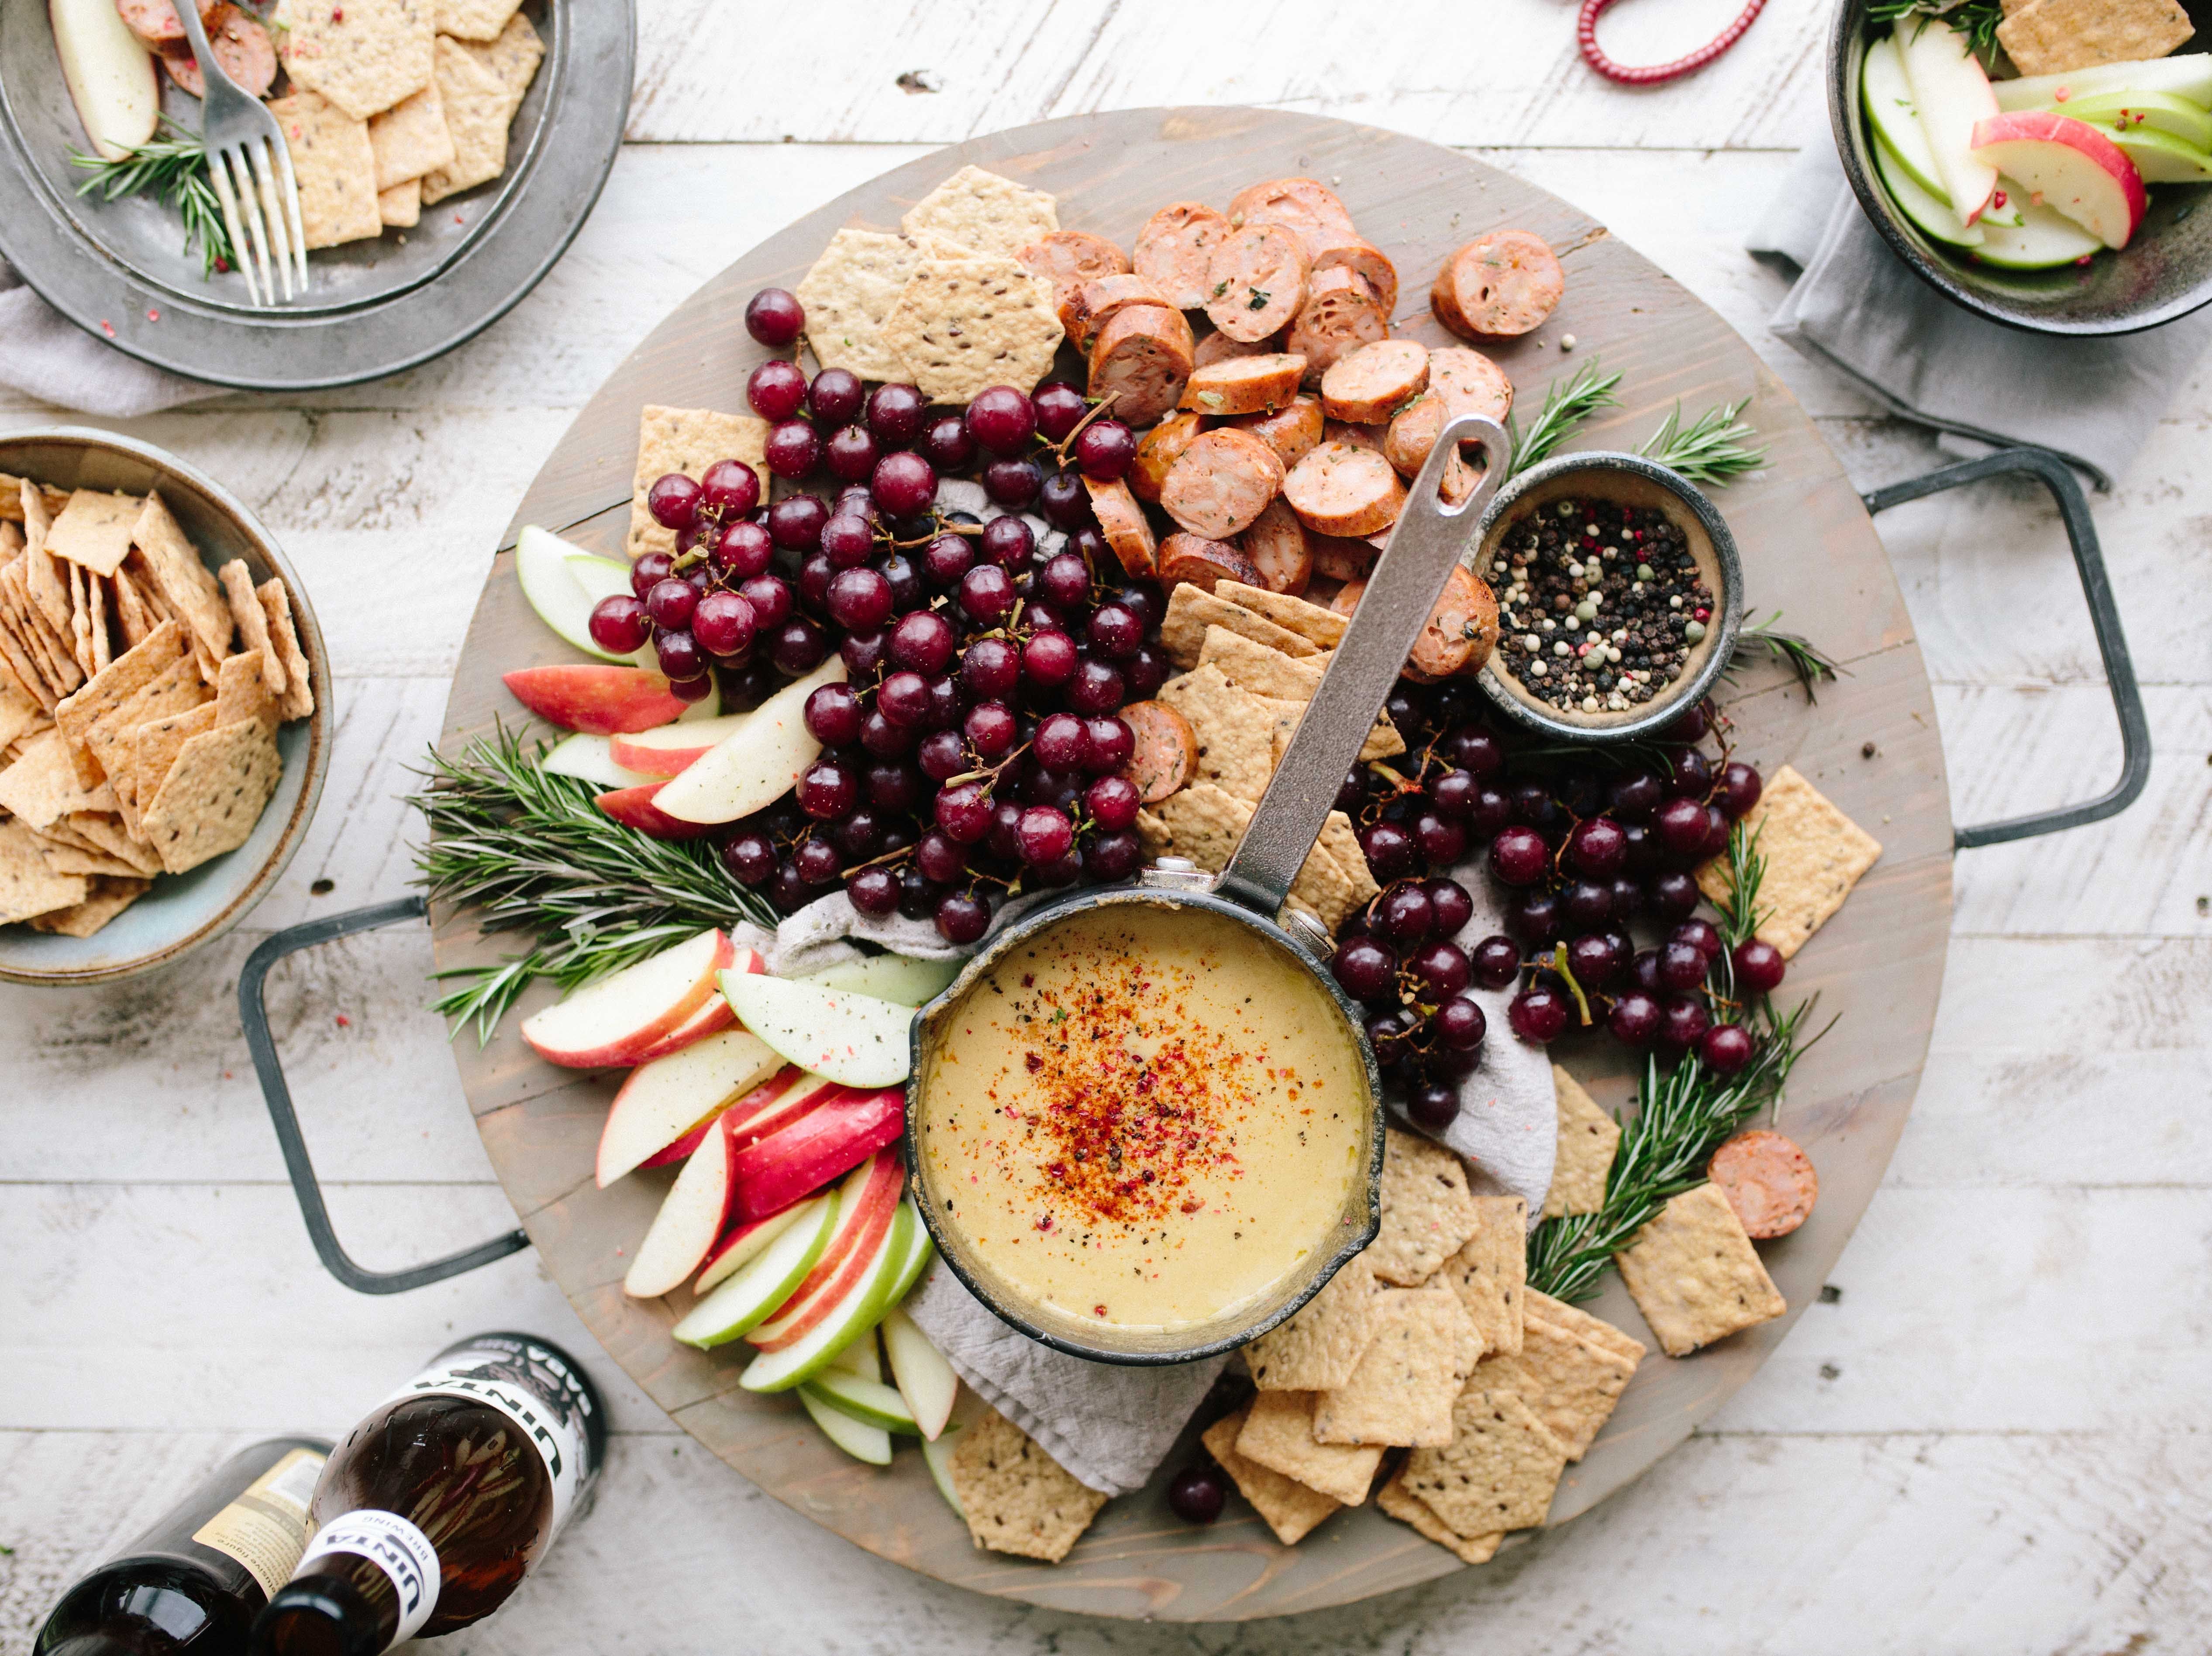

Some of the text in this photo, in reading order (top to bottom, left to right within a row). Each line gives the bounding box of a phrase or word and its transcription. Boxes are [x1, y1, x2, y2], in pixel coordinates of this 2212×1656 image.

[413, 1381, 562, 1480] UINTA
[217, 1539, 248, 1558] figure
[362, 1516, 428, 1561] BREWING
[250, 1558, 276, 1593] elusive
[325, 1535, 420, 1619] UINTA
